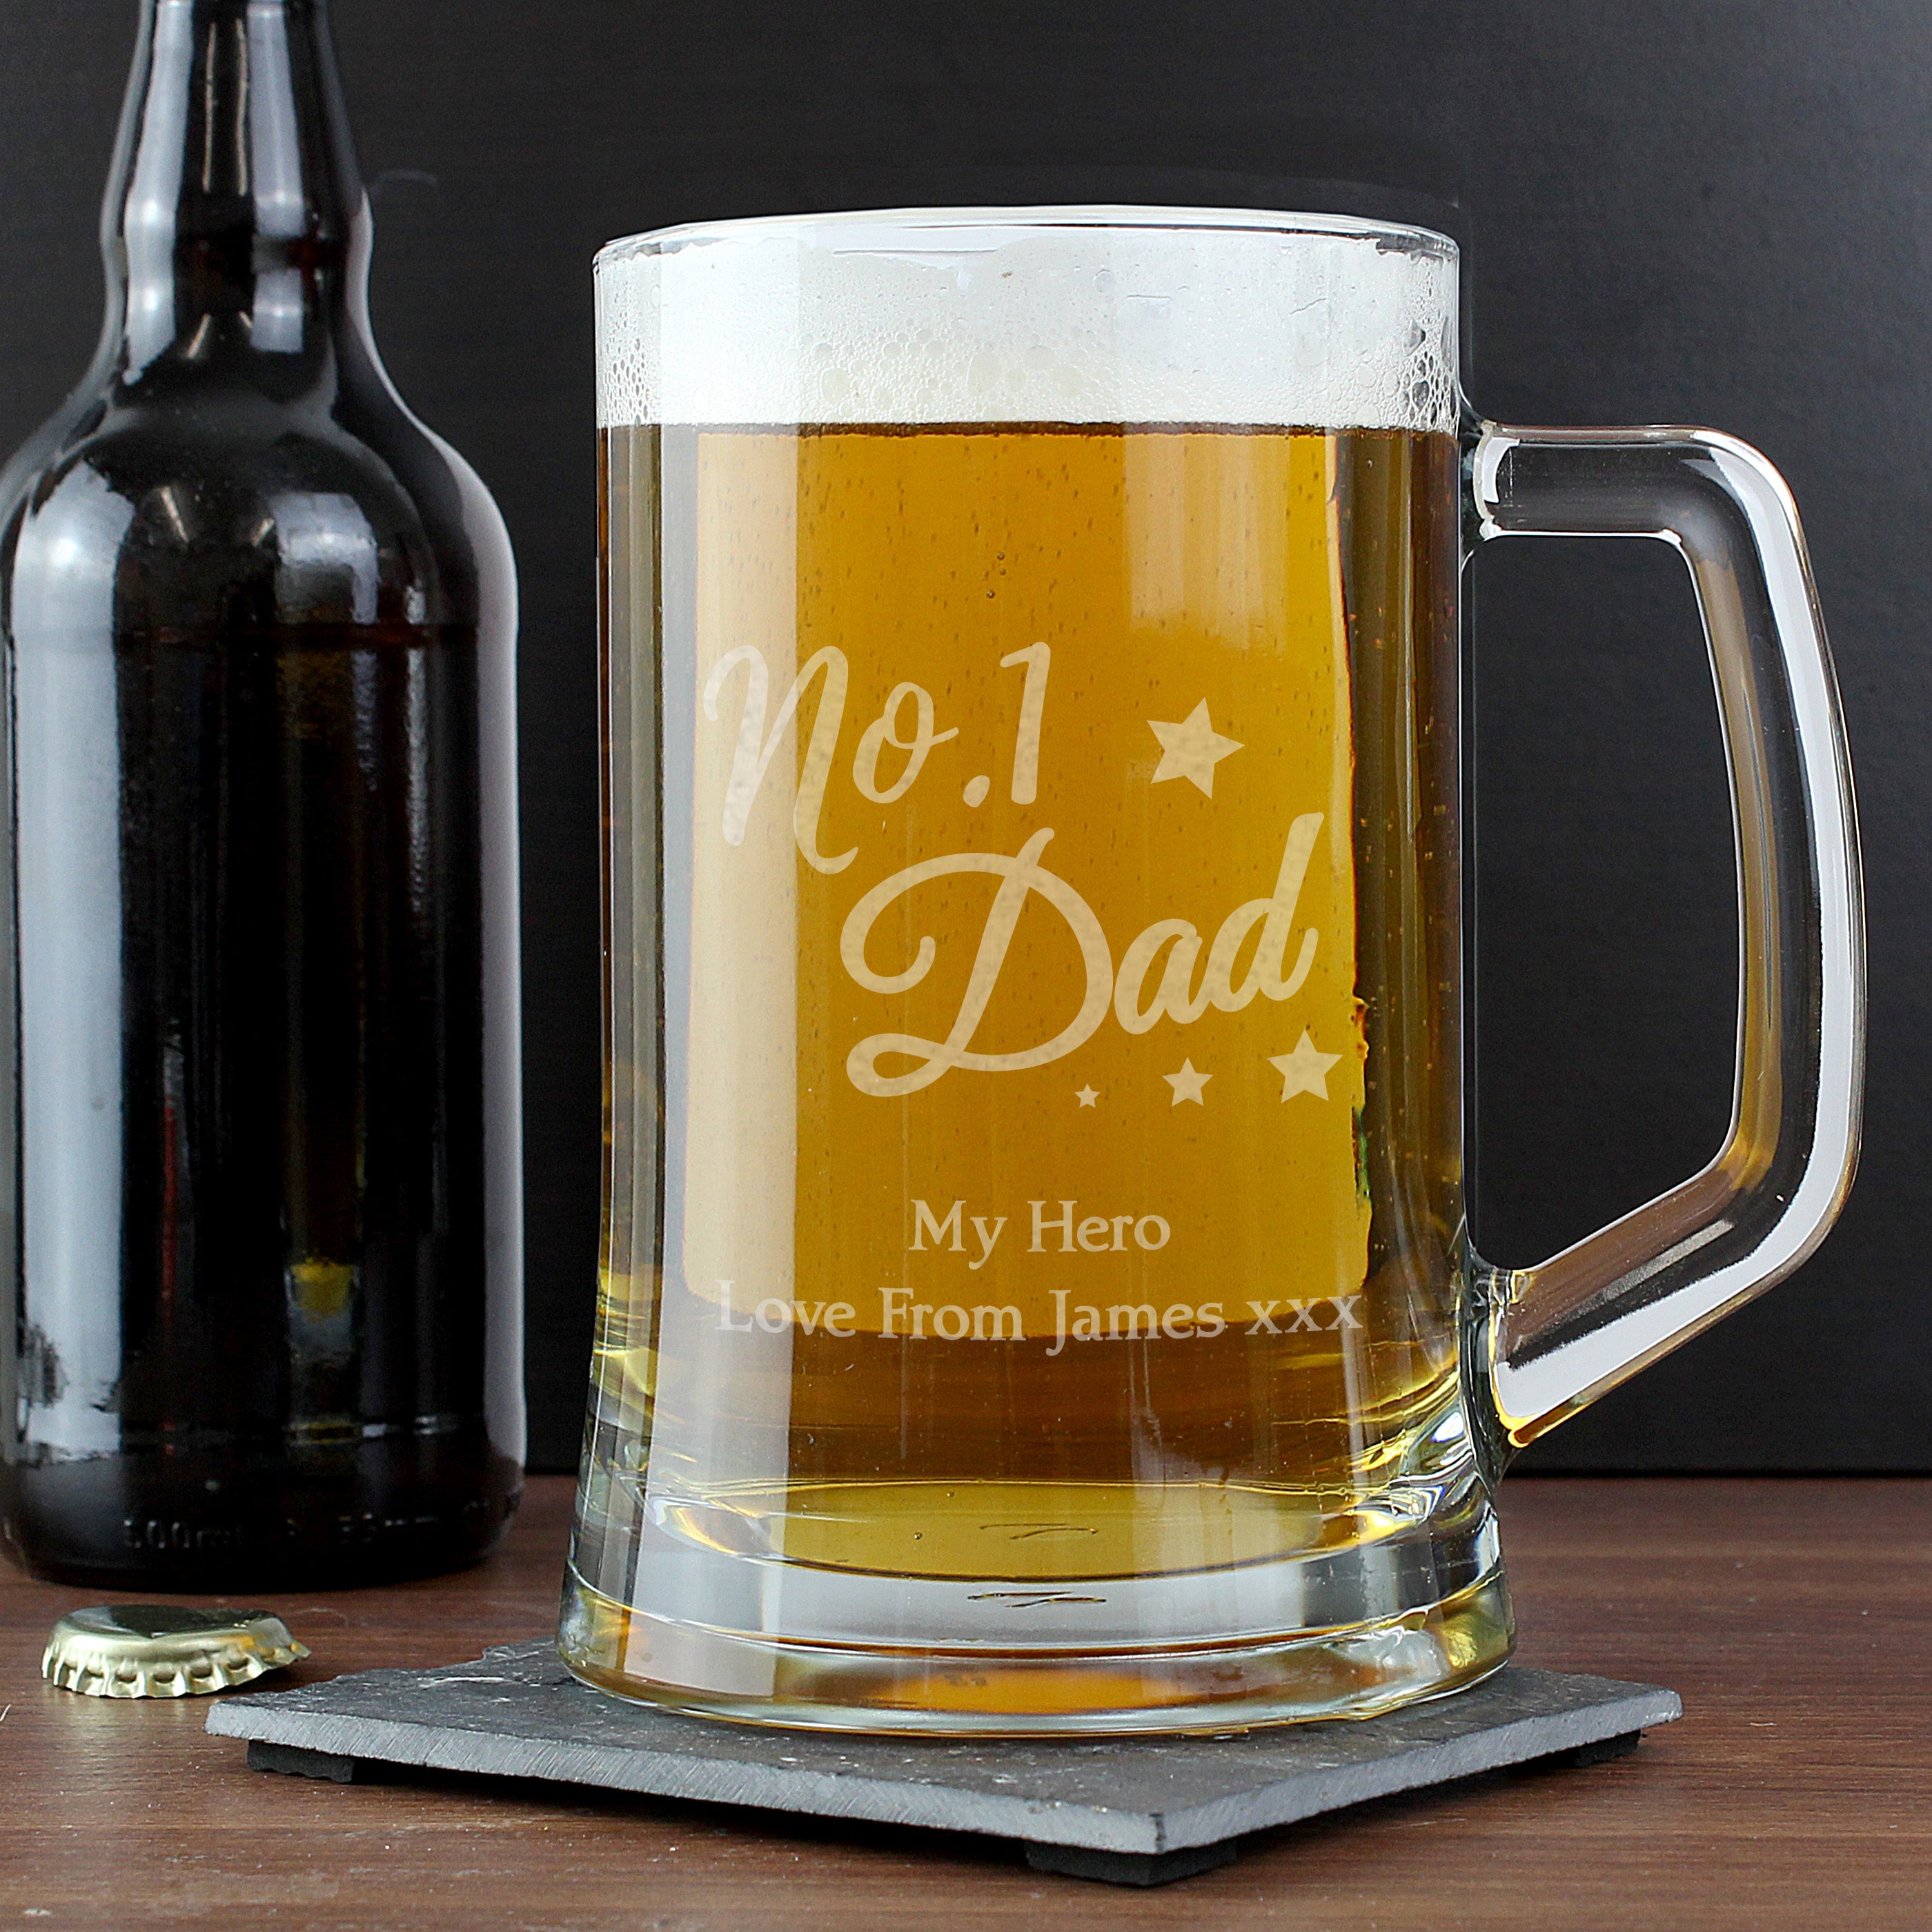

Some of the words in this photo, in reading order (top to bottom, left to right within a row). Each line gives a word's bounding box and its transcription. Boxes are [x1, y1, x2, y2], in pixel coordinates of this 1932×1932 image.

[840, 811, 1325, 1098] Dad
[908, 1199, 1007, 1270] My
[1026, 1199, 1171, 1252] Hero
[715, 1279, 856, 1338] Love
[877, 1287, 1027, 1342] From
[1045, 1289, 1225, 1357] James
[1245, 1294, 1363, 1336] xxx
